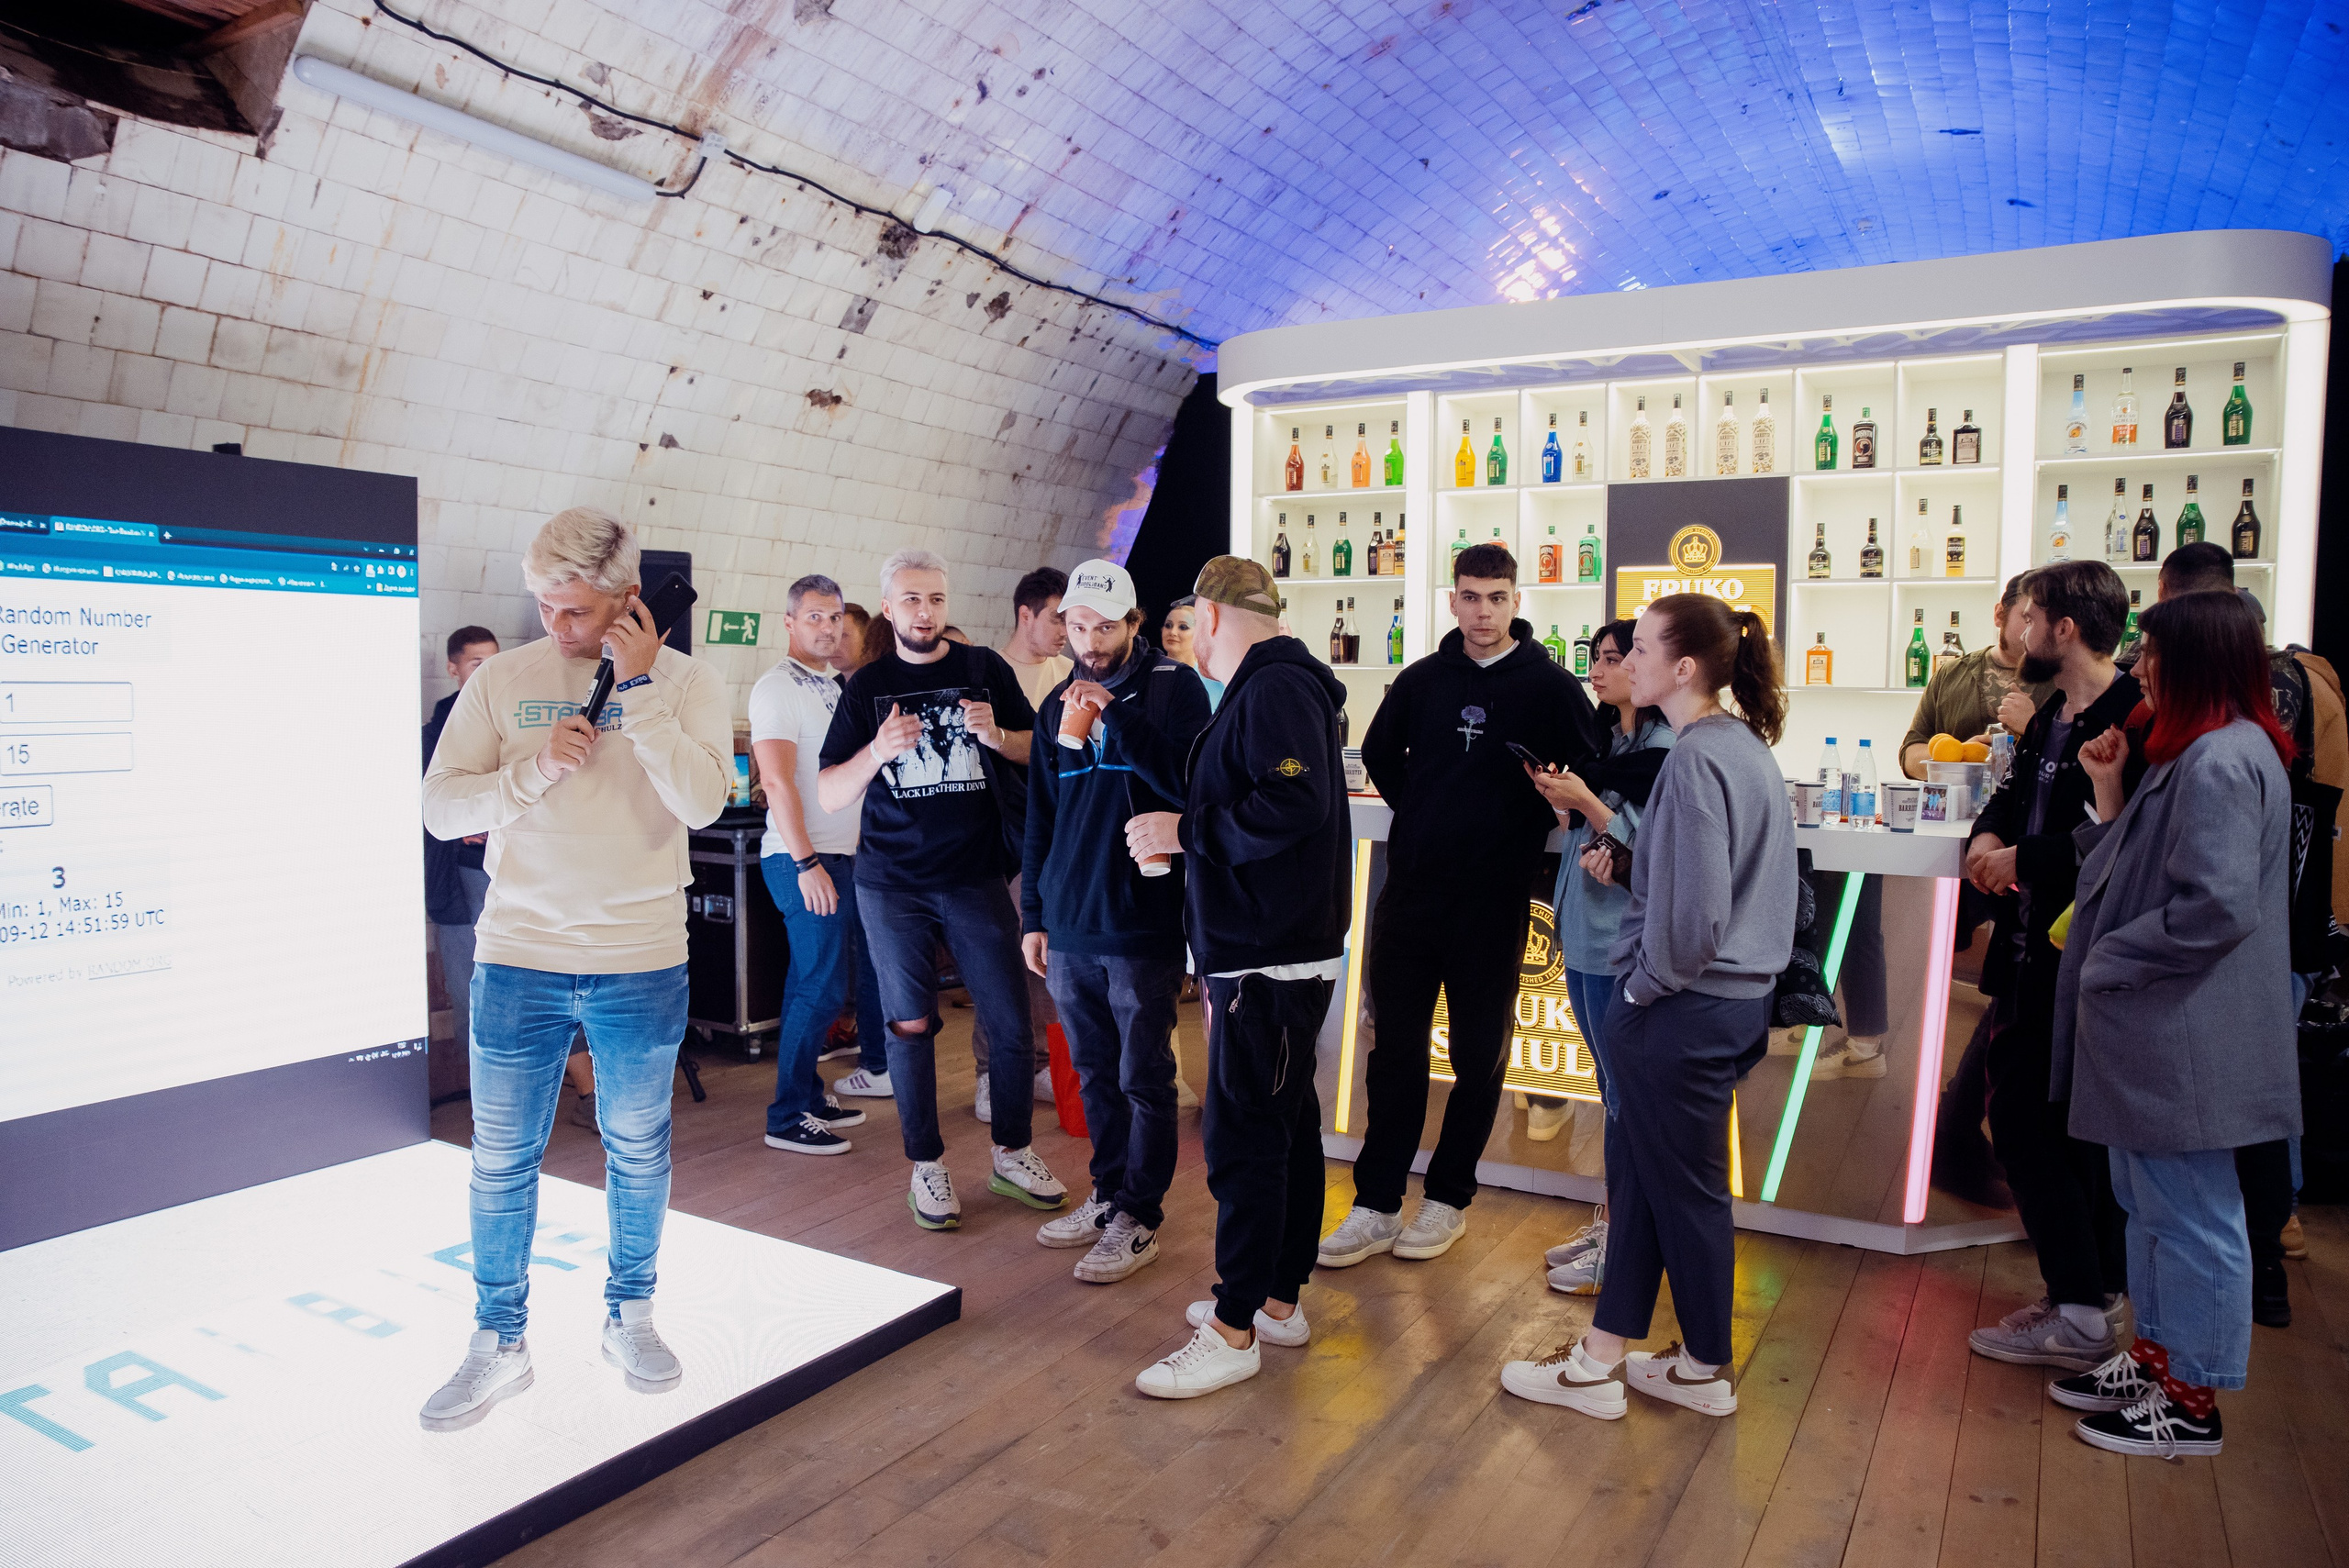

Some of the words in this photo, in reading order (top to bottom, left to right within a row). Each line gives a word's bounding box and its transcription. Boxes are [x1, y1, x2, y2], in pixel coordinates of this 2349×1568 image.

[80, 607, 152, 628] Number
[1, 633, 99, 654] Generator
[629, 675, 648, 686] EXPO
[6, 693, 15, 713] 1
[7, 744, 30, 764] 15
[51, 866, 66, 888] 3
[60, 896, 97, 913] Max:
[106, 891, 124, 908] 15
[56, 913, 129, 937] 14:51:59
[135, 909, 165, 928] UTC
[8, 969, 64, 987] Powered
[68, 966, 82, 980] by
[1544, 966, 1561, 980] 1898
